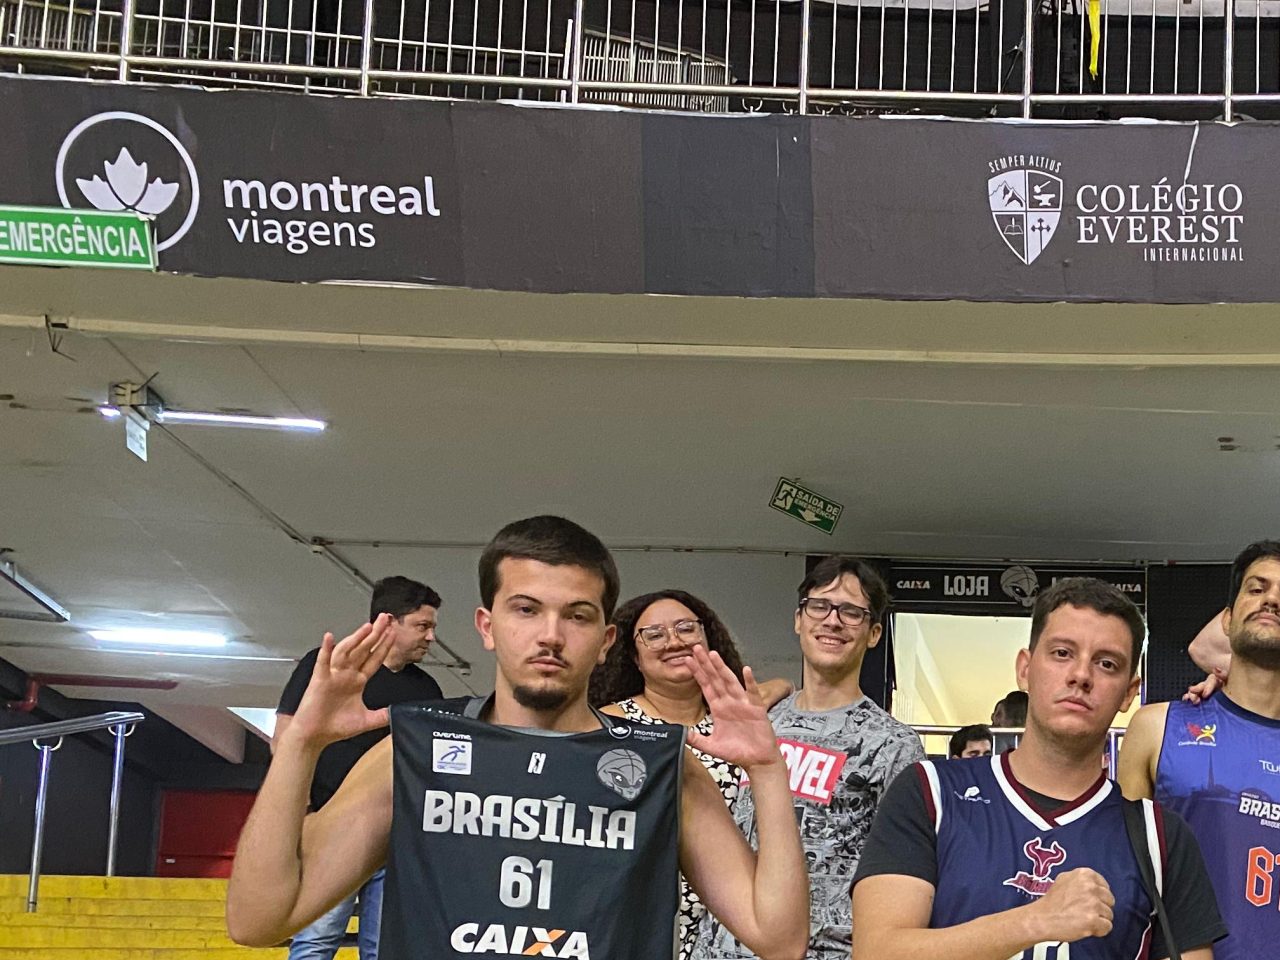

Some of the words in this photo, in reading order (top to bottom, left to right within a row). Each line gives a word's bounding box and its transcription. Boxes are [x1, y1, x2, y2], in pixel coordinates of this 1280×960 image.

[988, 154, 1025, 173] SEMPER
[1028, 154, 1062, 174] ALTIUS
[223, 176, 441, 217] montreal
[1076, 176, 1243, 213] COLÉGIO
[0, 216, 146, 257] EMERGÊNCIA
[227, 211, 376, 254] viagens
[1077, 215, 1244, 244] EVEREST
[1144, 247, 1244, 262] INTERNACIONAL
[826, 504, 840, 516] DE
[896, 580, 930, 589] CAIXA
[943, 575, 989, 596] LOJA
[1111, 583, 1142, 592] AIXA
[633, 729, 668, 738] montreal
[422, 790, 637, 850] BRASÍLIA
[499, 855, 554, 909] 61
